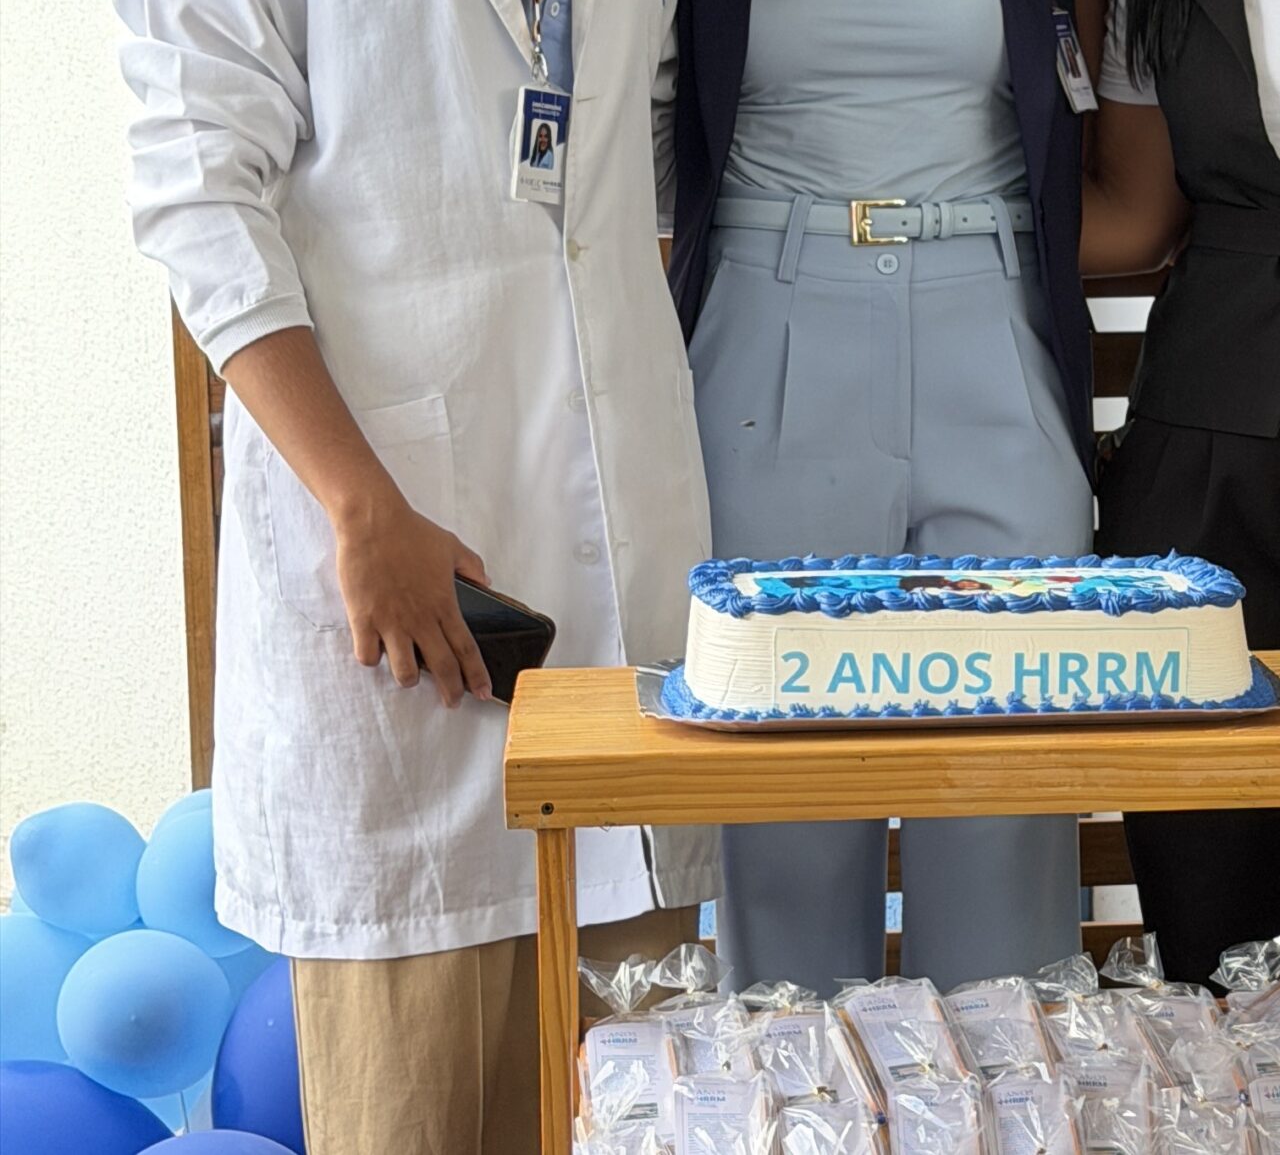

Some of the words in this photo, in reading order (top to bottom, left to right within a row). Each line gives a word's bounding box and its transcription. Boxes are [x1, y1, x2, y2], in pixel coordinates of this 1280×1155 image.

[780, 650, 811, 694] 2
[825, 650, 993, 695] ANOS
[1014, 650, 1181, 697] HRRM
